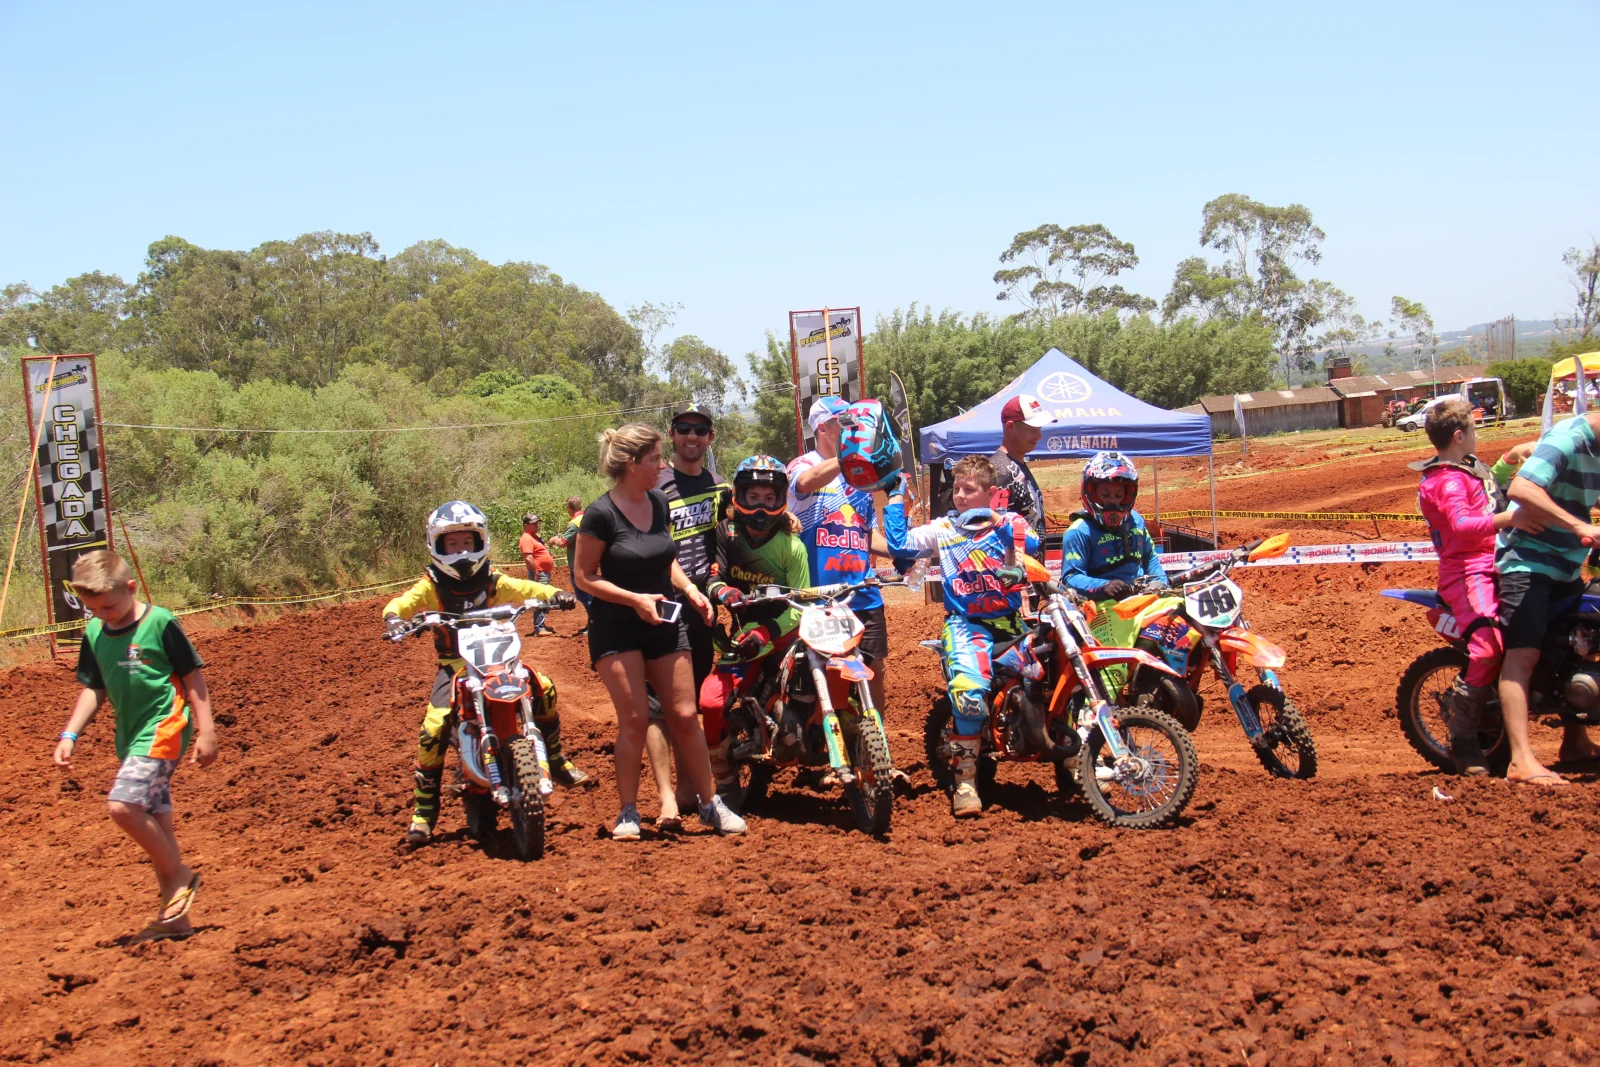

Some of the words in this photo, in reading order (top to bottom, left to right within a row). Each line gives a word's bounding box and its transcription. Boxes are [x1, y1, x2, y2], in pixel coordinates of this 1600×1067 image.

[1062, 435, 1118, 449] YAMAHA
[53, 405, 90, 537] CHEGADA
[670, 503, 701, 519] PRO
[675, 512, 712, 530] TORK
[816, 527, 849, 549] Red
[1160, 554, 1183, 565] ORILLI
[1307, 546, 1340, 558] BORILLI
[1363, 544, 1397, 556] BORILLI
[824, 554, 866, 573] KTM
[731, 565, 776, 584] Charles
[952, 575, 983, 596] Red
[967, 596, 1009, 615] KTM
[1198, 584, 1238, 618] 46
[18, 627, 36, 636] TORK
[45, 625, 59, 633] PRO
[59, 622, 76, 630] TORK
[806, 617, 856, 639] 899
[466, 635, 514, 667] 17
